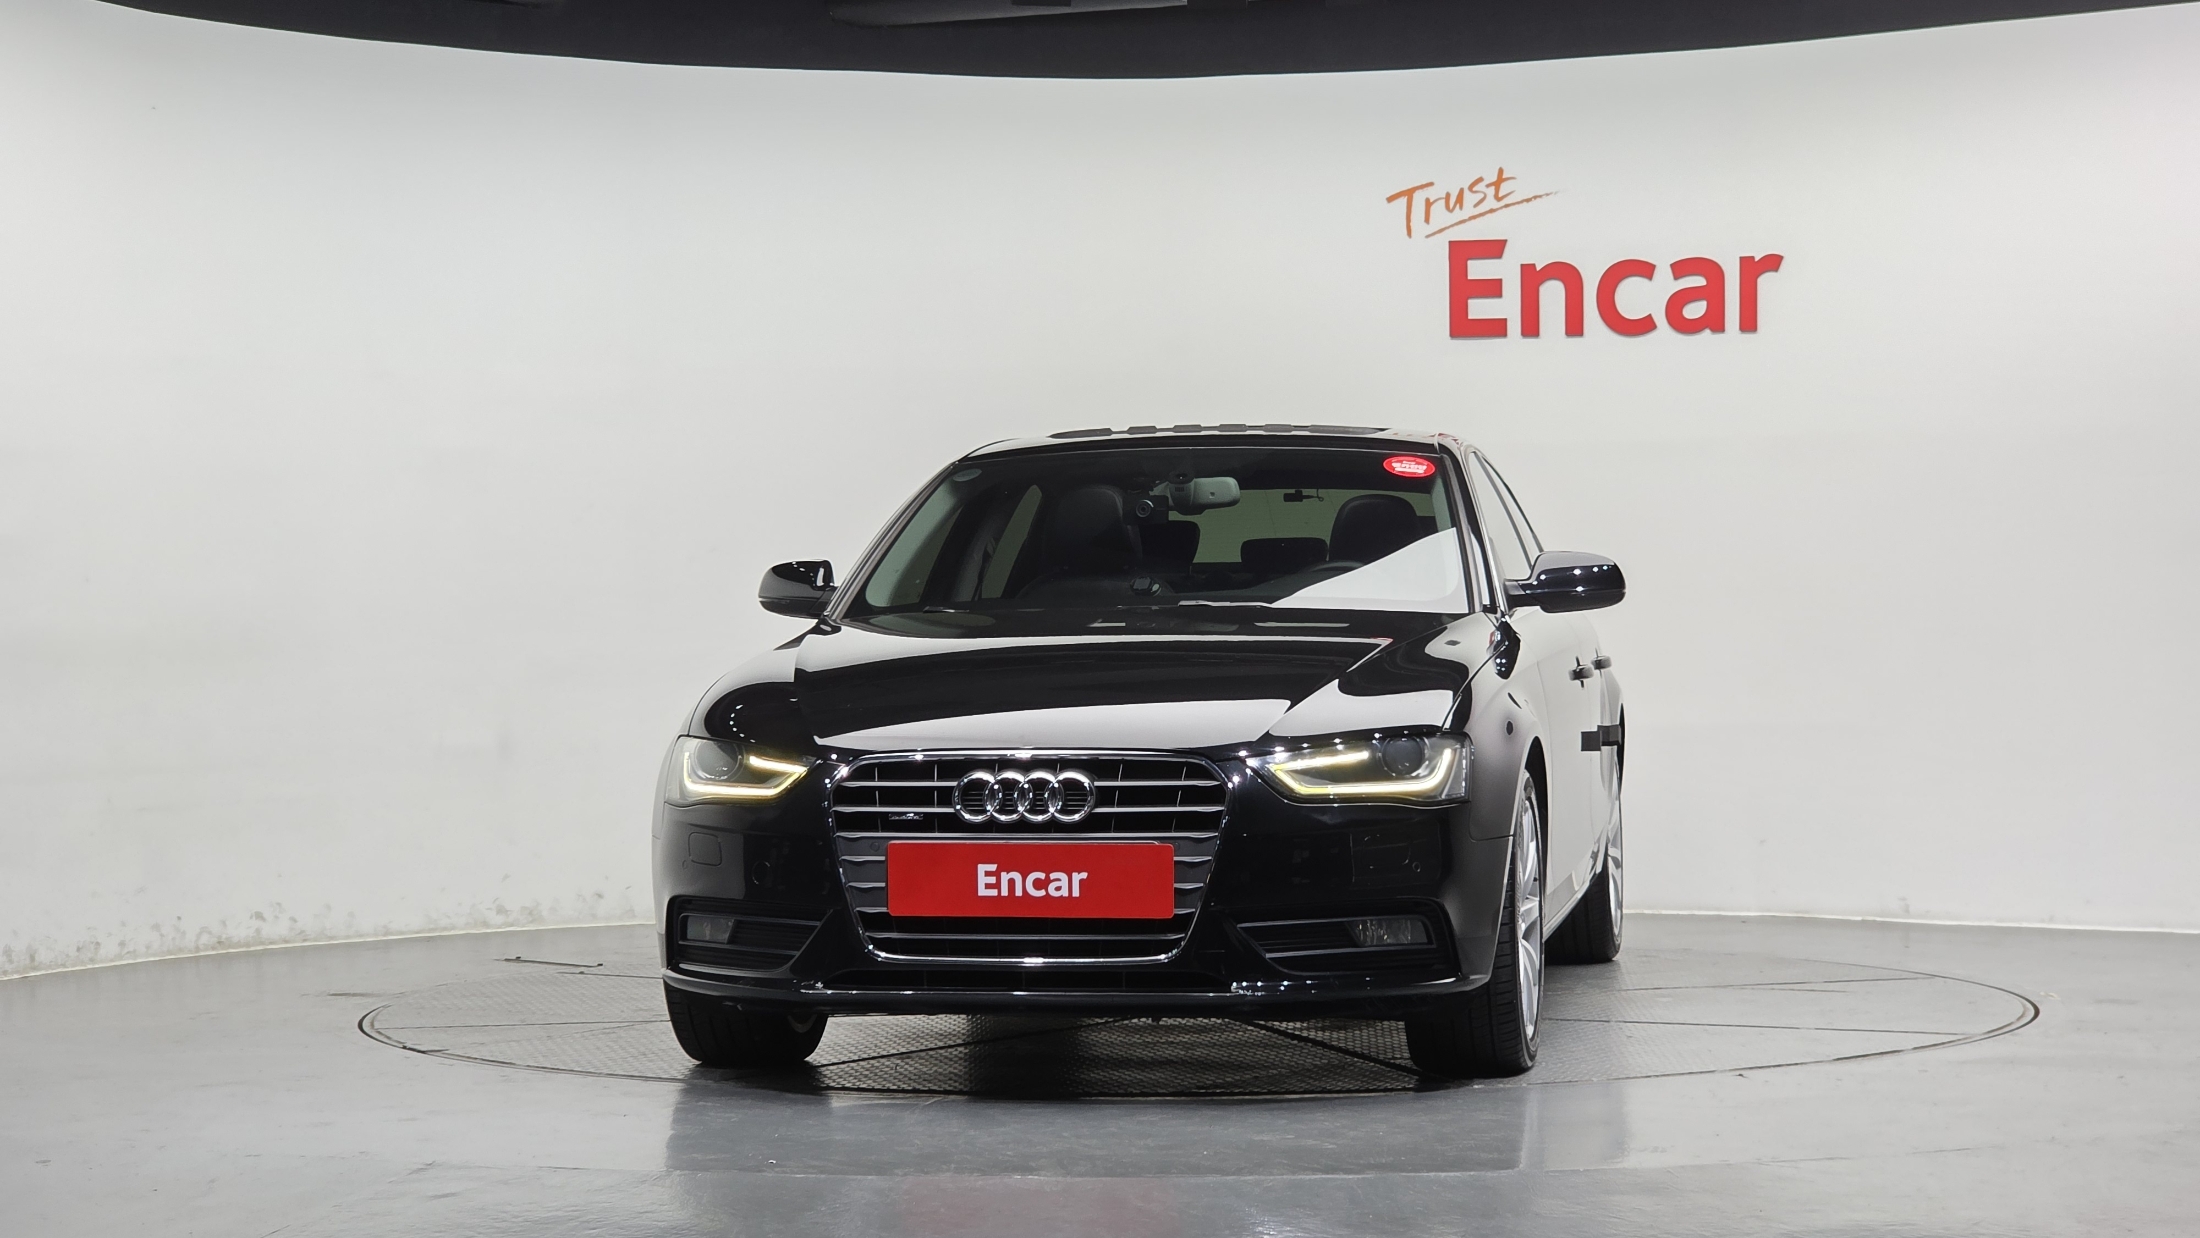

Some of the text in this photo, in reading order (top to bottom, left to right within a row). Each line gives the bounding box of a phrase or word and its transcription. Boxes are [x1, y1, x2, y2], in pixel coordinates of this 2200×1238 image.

[1386, 167, 1517, 238] Trust
[1448, 239, 1784, 337] Encar
[977, 863, 1088, 897] Encar
